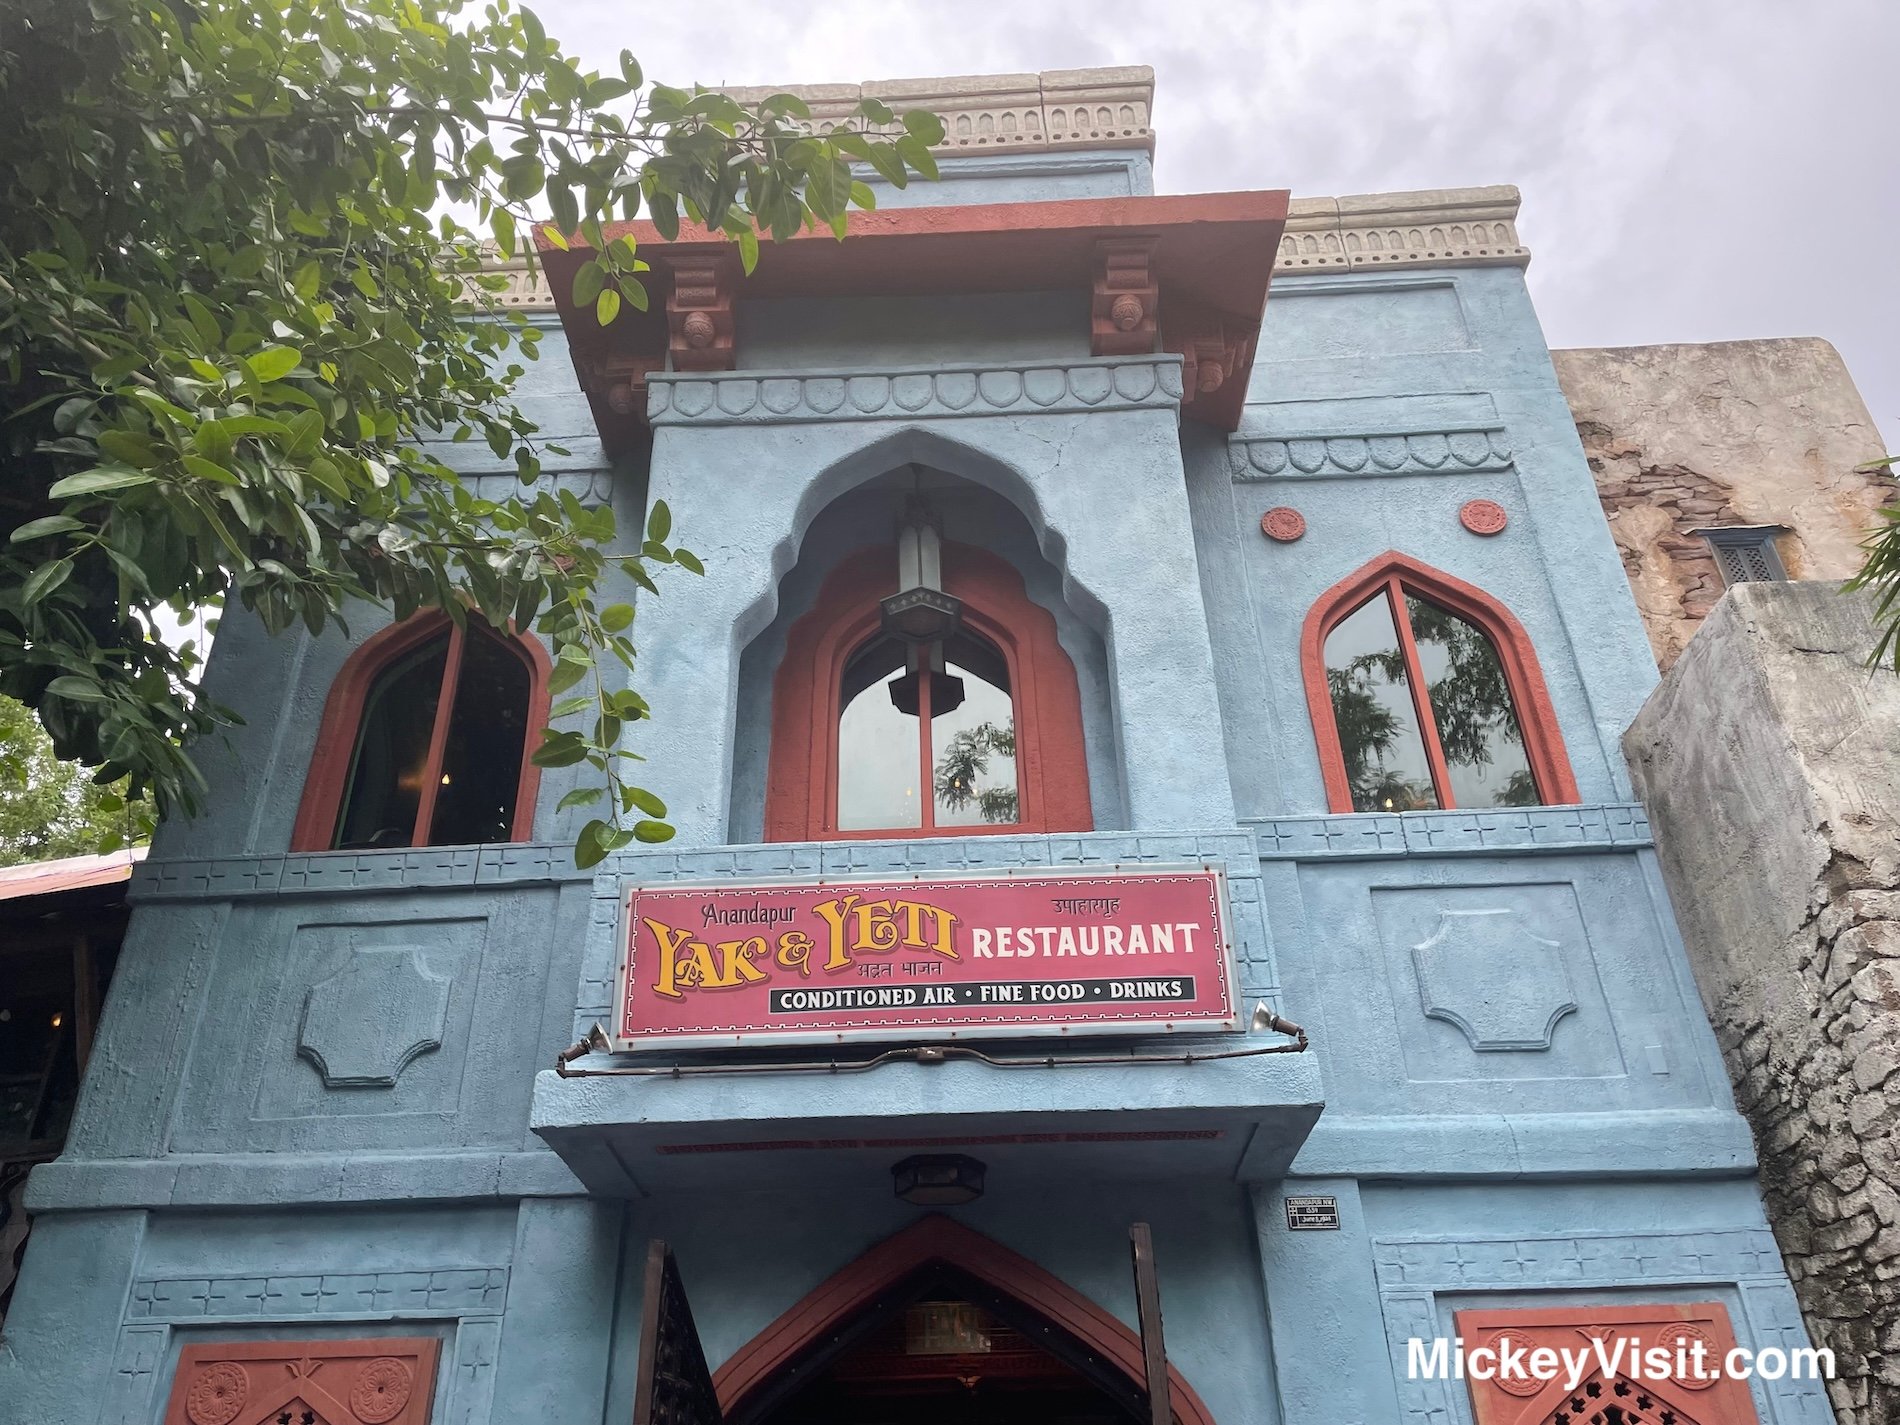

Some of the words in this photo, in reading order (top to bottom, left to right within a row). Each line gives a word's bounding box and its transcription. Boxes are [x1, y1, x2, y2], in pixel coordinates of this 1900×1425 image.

[702, 901, 796, 931] Anandapur
[776, 931, 815, 976] &
[811, 894, 960, 971] YETI
[972, 922, 1201, 959] RESTAURANT
[780, 988, 917, 1009] CONDITIONED
[922, 987, 957, 1004] AIR
[980, 985, 1024, 1002] FINE
[1030, 983, 1085, 1001] FOOD
[1109, 980, 1183, 999] DRINKS
